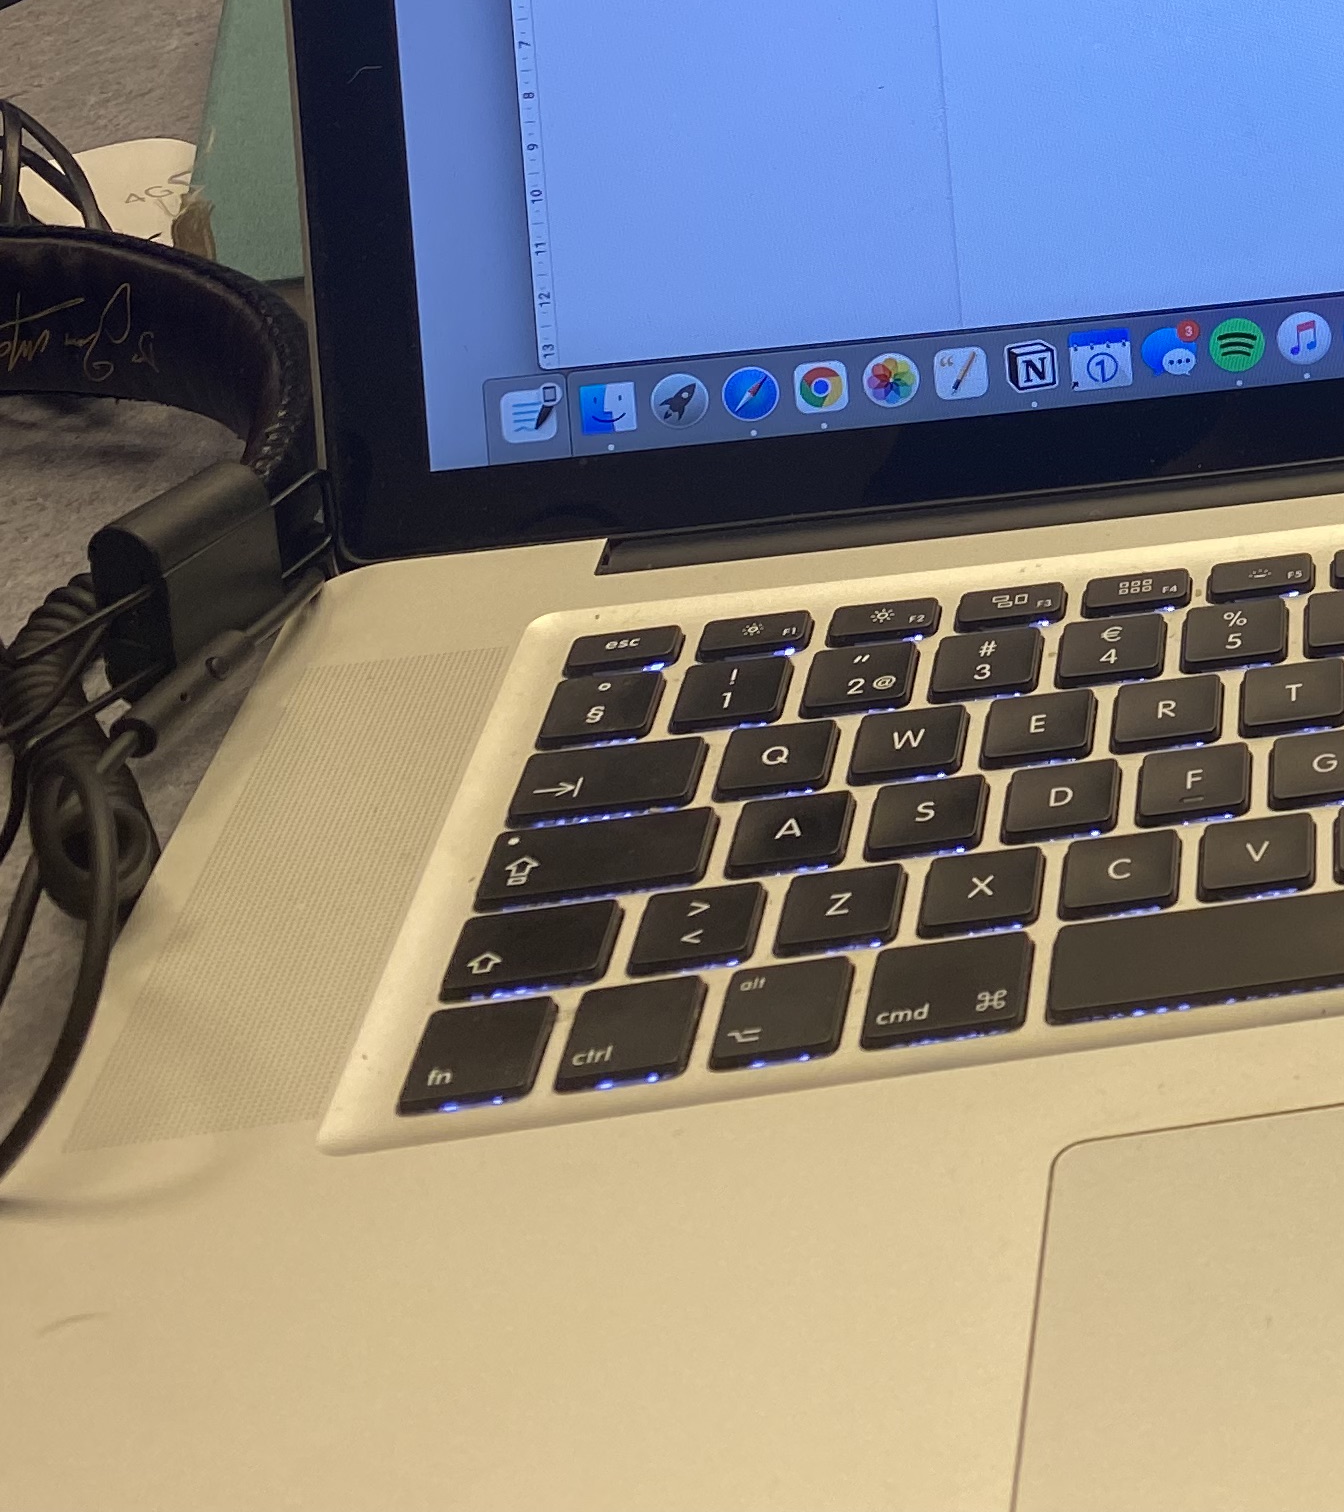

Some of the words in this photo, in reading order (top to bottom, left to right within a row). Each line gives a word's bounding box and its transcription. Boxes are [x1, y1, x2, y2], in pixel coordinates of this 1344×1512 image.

[605, 637, 640, 649] esc
[1286, 685, 1303, 702] T
[1158, 701, 1176, 718] R
[1031, 715, 1046, 733] E
[893, 729, 925, 749] W
[762, 746, 789, 766] Q
[1312, 753, 1337, 773] G
[1186, 770, 1203, 788] F
[1049, 788, 1073, 807] D
[915, 802, 935, 821] S
[775, 818, 802, 839] A
[1245, 841, 1270, 863] V
[1108, 859, 1131, 879] C
[968, 876, 995, 899] X
[824, 894, 852, 916] Z
[740, 976, 765, 991] alt
[876, 1004, 929, 1026] cmd
[572, 1047, 613, 1066] ctrl
[427, 1069, 451, 1086] fn
